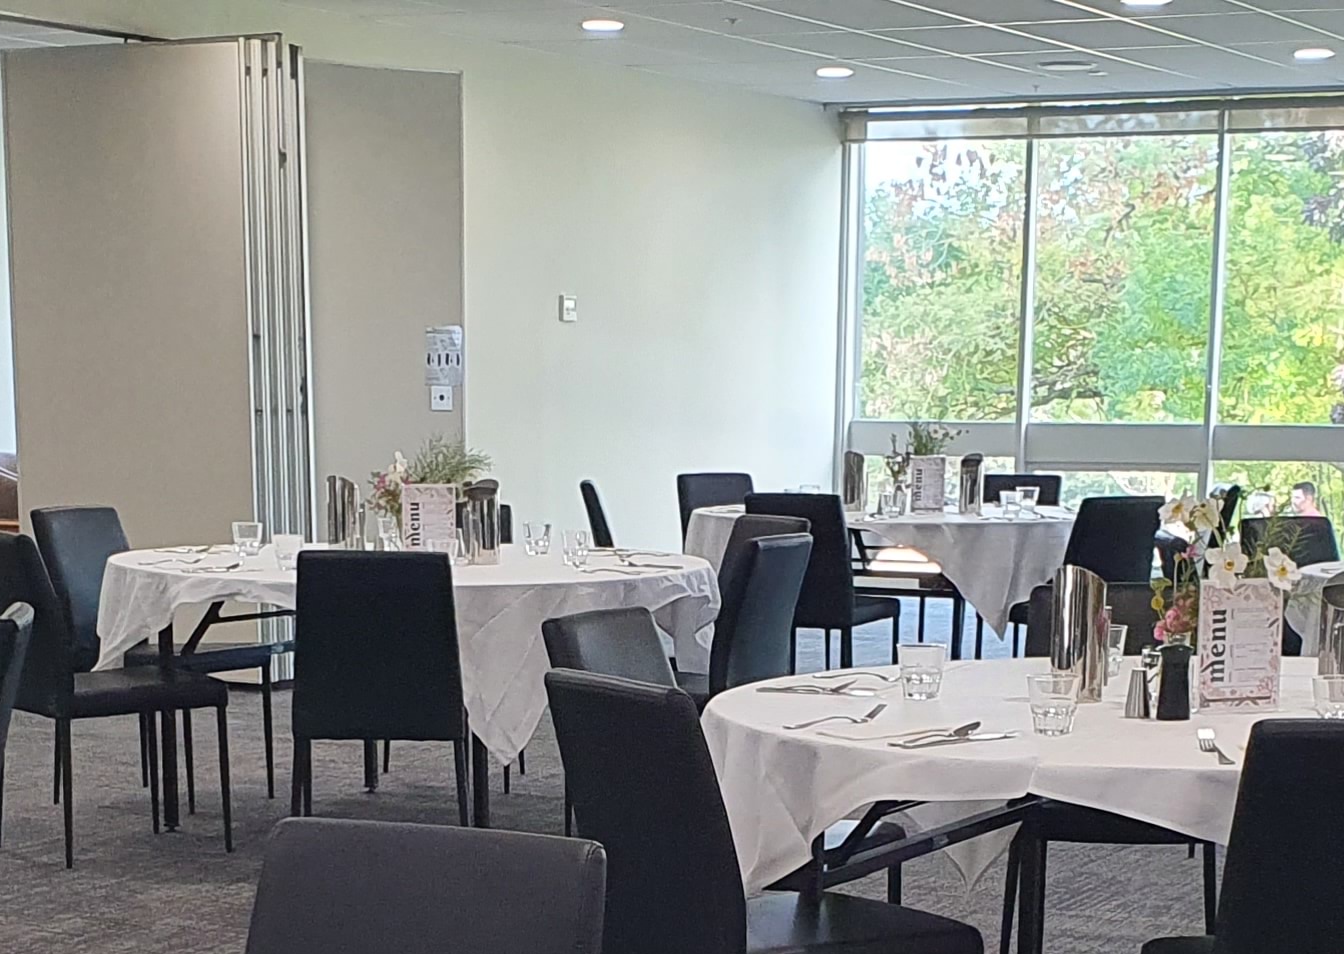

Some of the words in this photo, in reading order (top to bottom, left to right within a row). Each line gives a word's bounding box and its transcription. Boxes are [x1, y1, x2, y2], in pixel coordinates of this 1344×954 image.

[913, 468, 923, 501] menu
[405, 502, 421, 546] menu
[1200, 608, 1227, 683] menu
